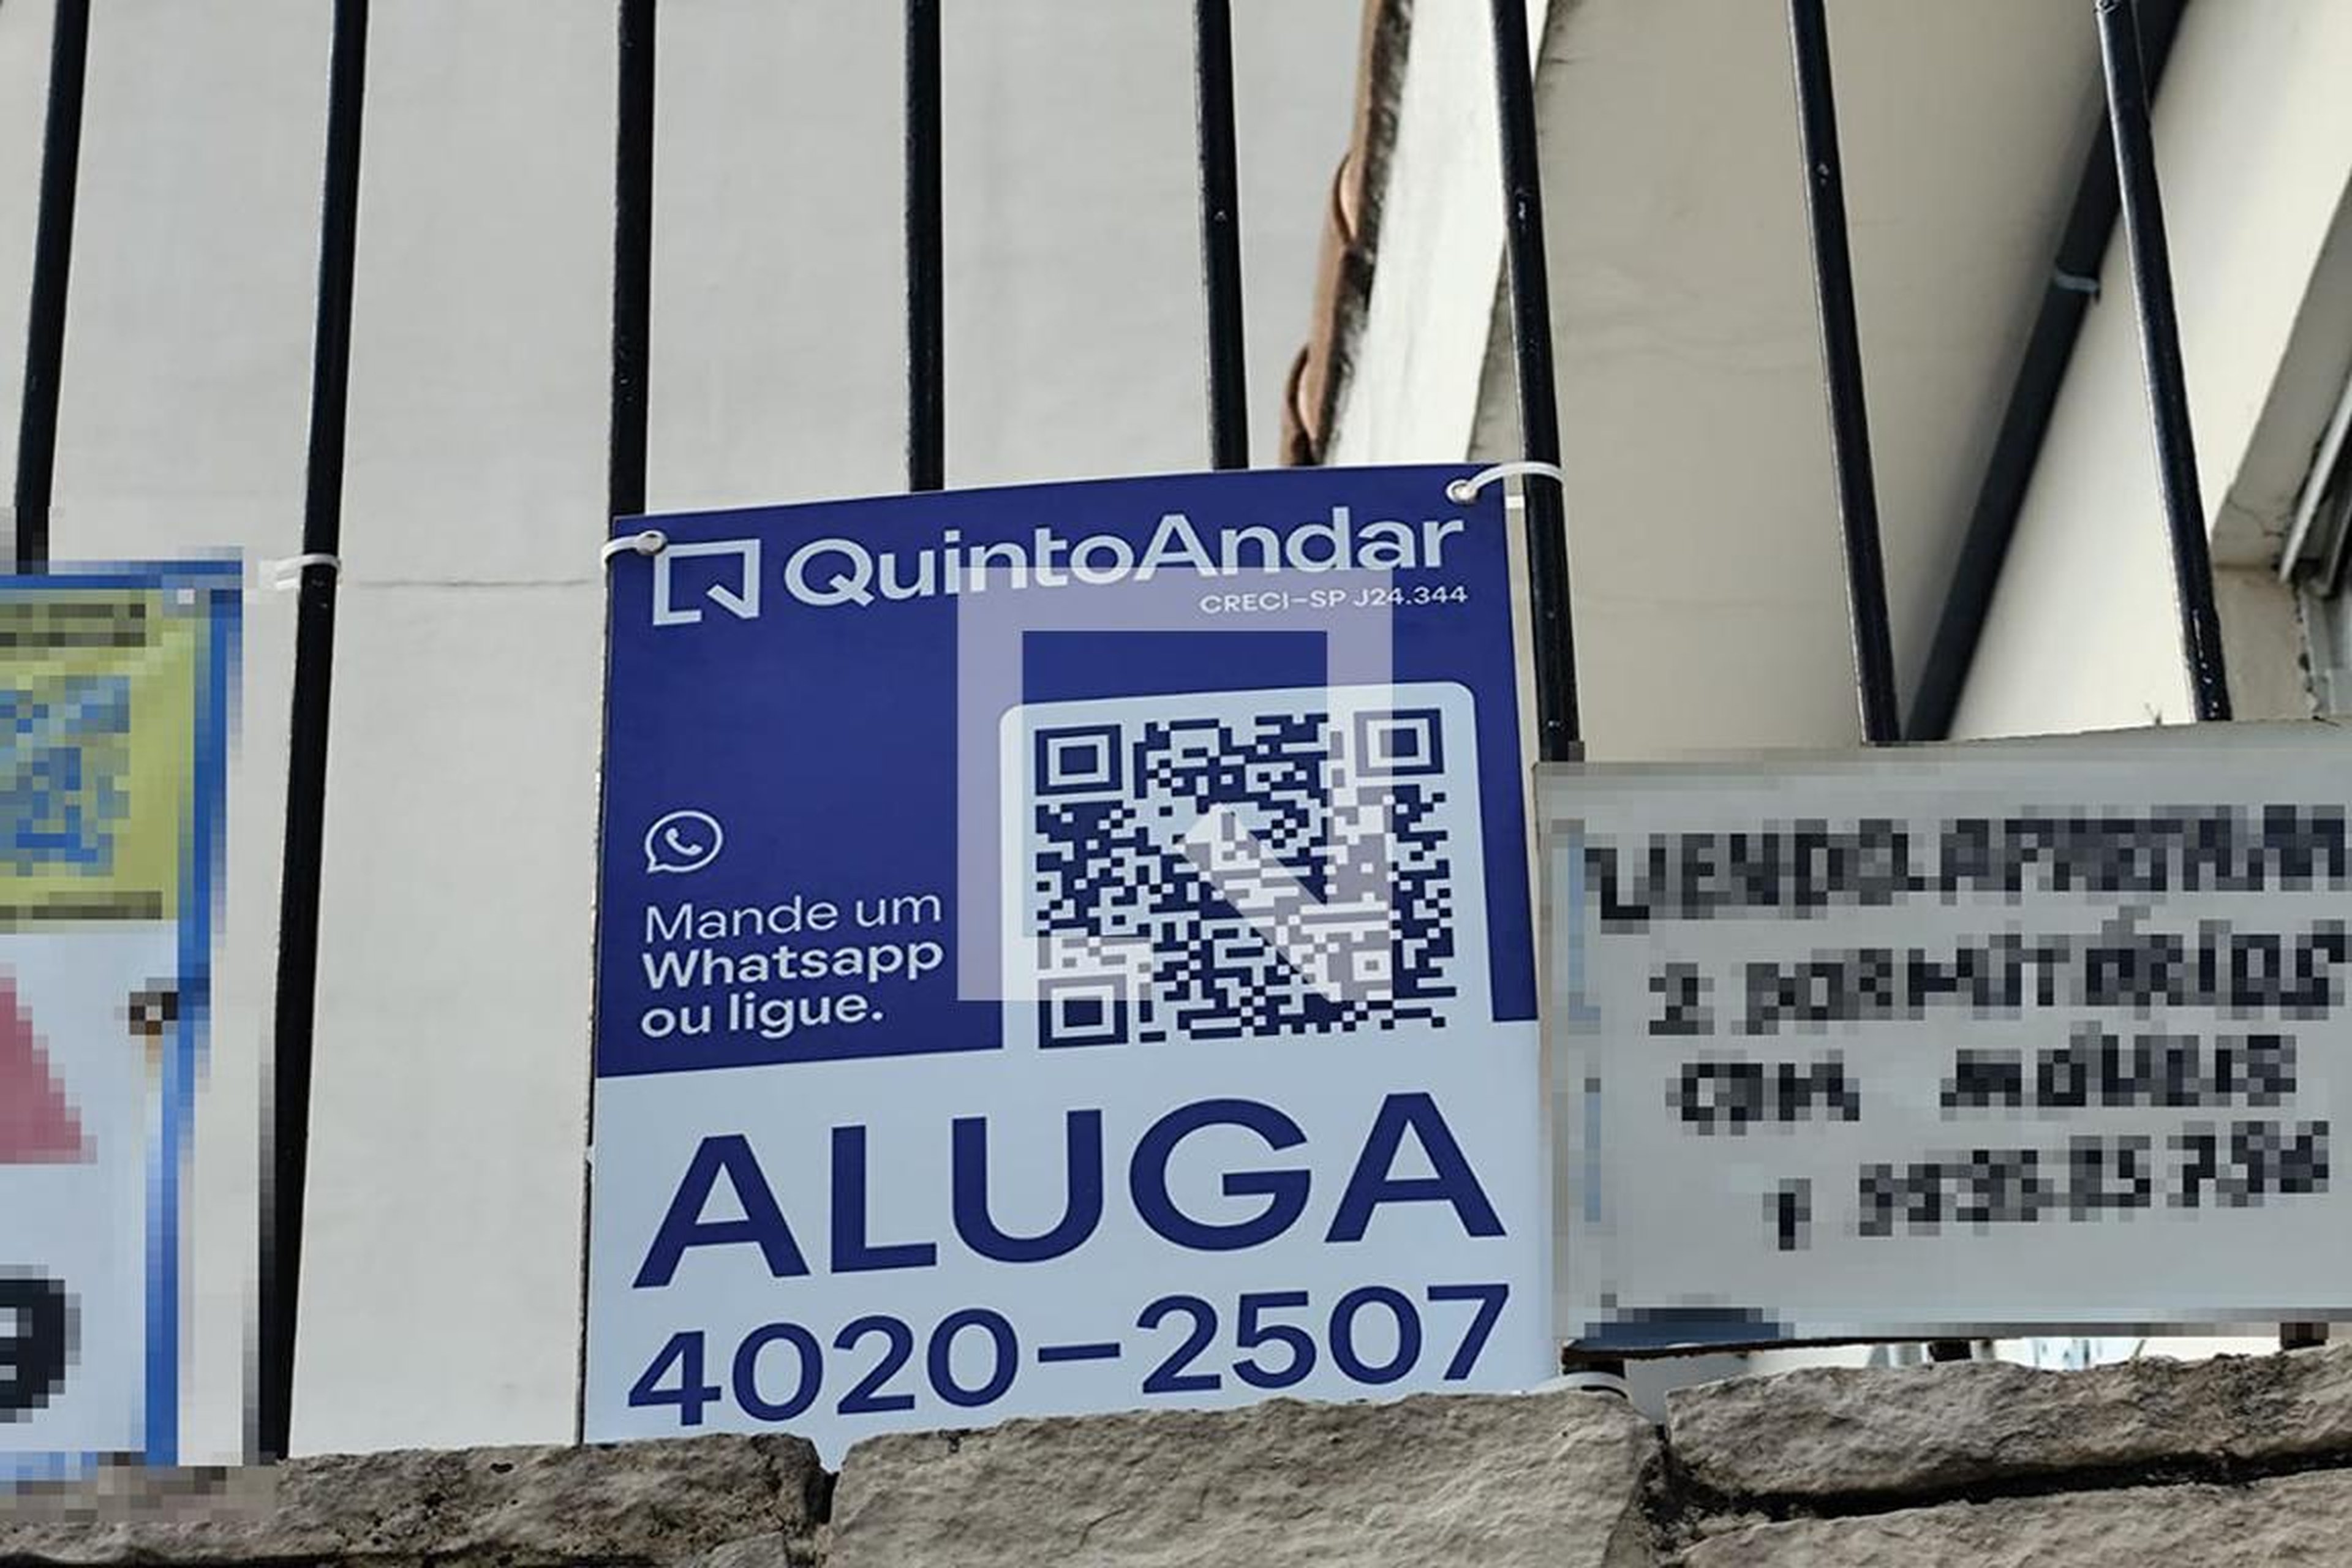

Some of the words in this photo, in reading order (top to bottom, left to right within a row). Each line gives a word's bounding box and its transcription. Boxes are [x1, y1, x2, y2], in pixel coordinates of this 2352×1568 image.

[783, 506, 1464, 607] QuintoAndar
[1354, 586, 1469, 607] J24.344
[645, 895, 838, 943] Mande
[856, 894, 941, 927] um
[641, 941, 944, 990] Whatsapp
[641, 1005, 711, 1038] ou
[729, 990, 883, 1039] ligue.
[632, 1092, 1507, 1289] ALUGA
